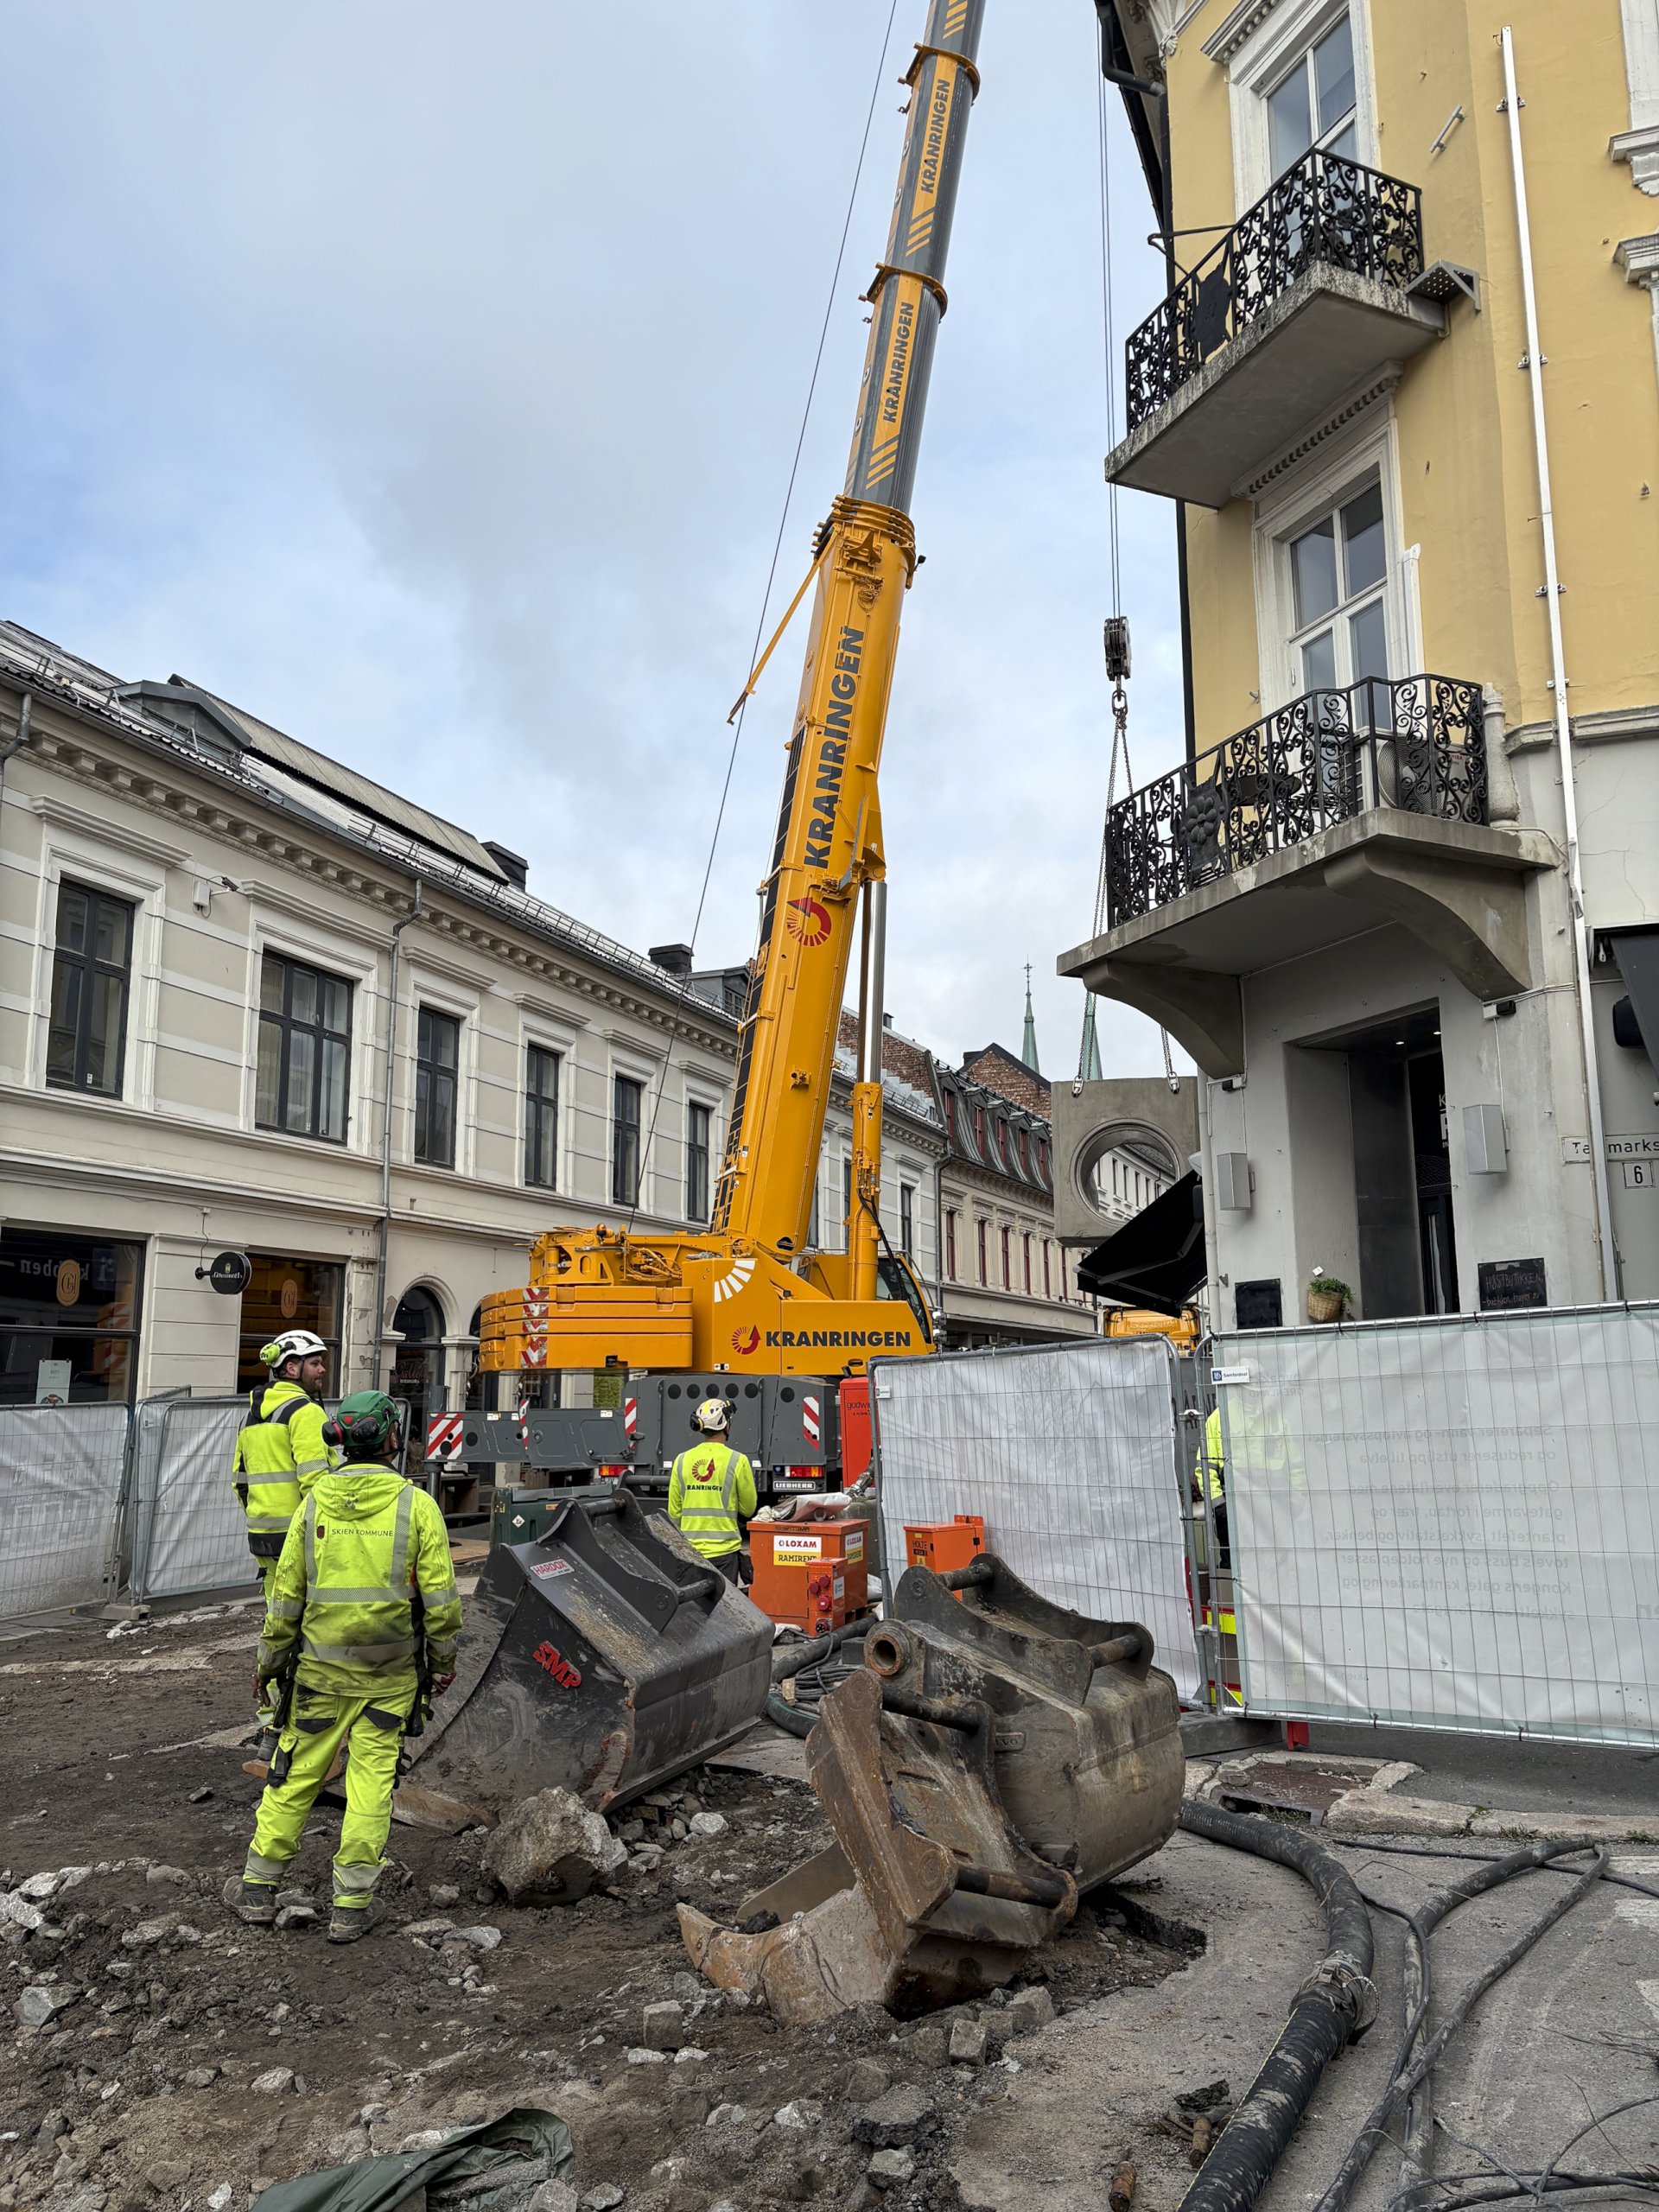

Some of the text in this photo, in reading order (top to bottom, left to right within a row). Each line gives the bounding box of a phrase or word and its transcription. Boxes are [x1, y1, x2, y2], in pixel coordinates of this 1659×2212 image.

[920, 79, 950, 194] KRANRINGEN
[883, 302, 914, 423] KRANRINGEN
[804, 625, 865, 869] KRANRINGEN
[1633, 1165, 1643, 1184] 6
[766, 1331, 911, 1347] KRANRINGEN
[785, 1540, 817, 1548] LOXAM
[912, 1540, 928, 1549] HOLTE
[533, 1559, 568, 1576] HARDOX
[532, 1640, 582, 1690] SMP
